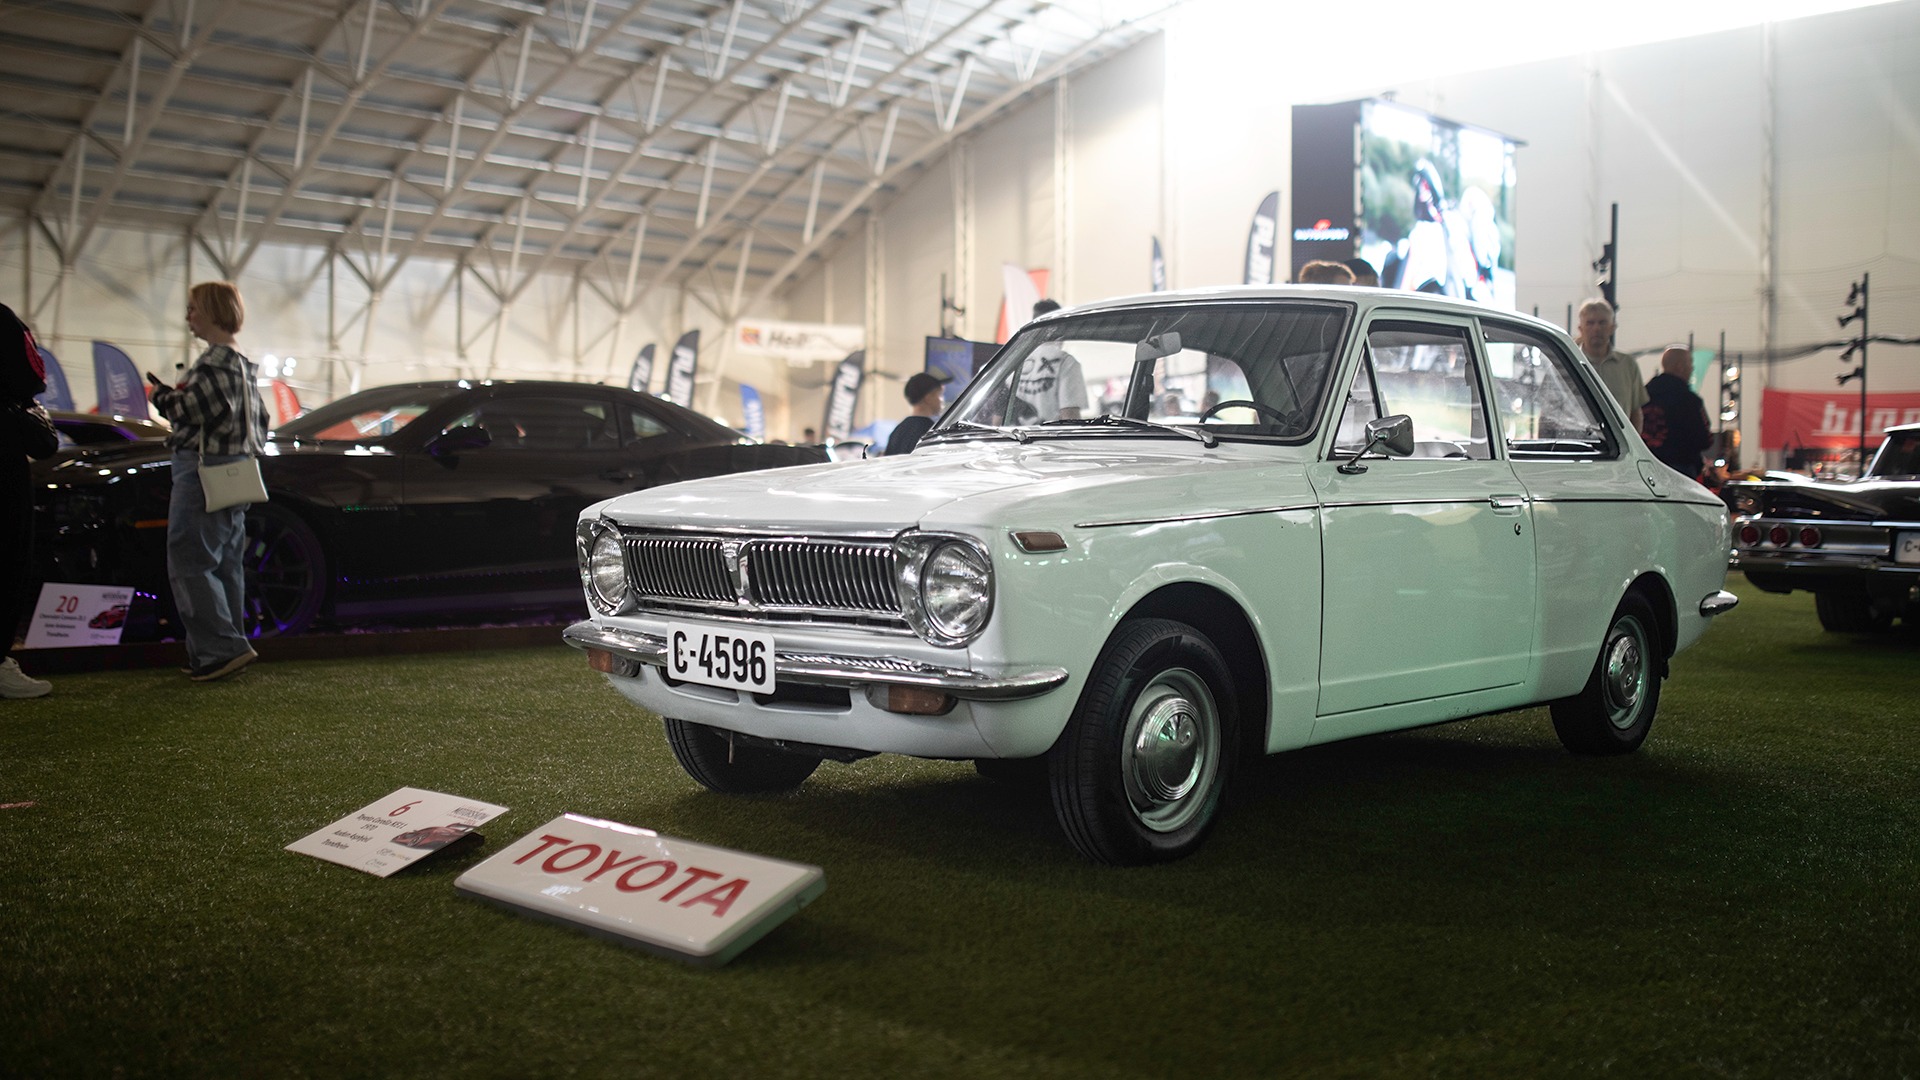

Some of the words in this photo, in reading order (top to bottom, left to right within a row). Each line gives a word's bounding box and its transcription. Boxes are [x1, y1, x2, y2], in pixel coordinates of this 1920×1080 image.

[1904, 540, 1920, 553] C-
[55, 595, 79, 613] 20
[674, 631, 766, 685] C-4596
[388, 800, 423, 817] 6
[513, 834, 750, 918] TOYOTA
